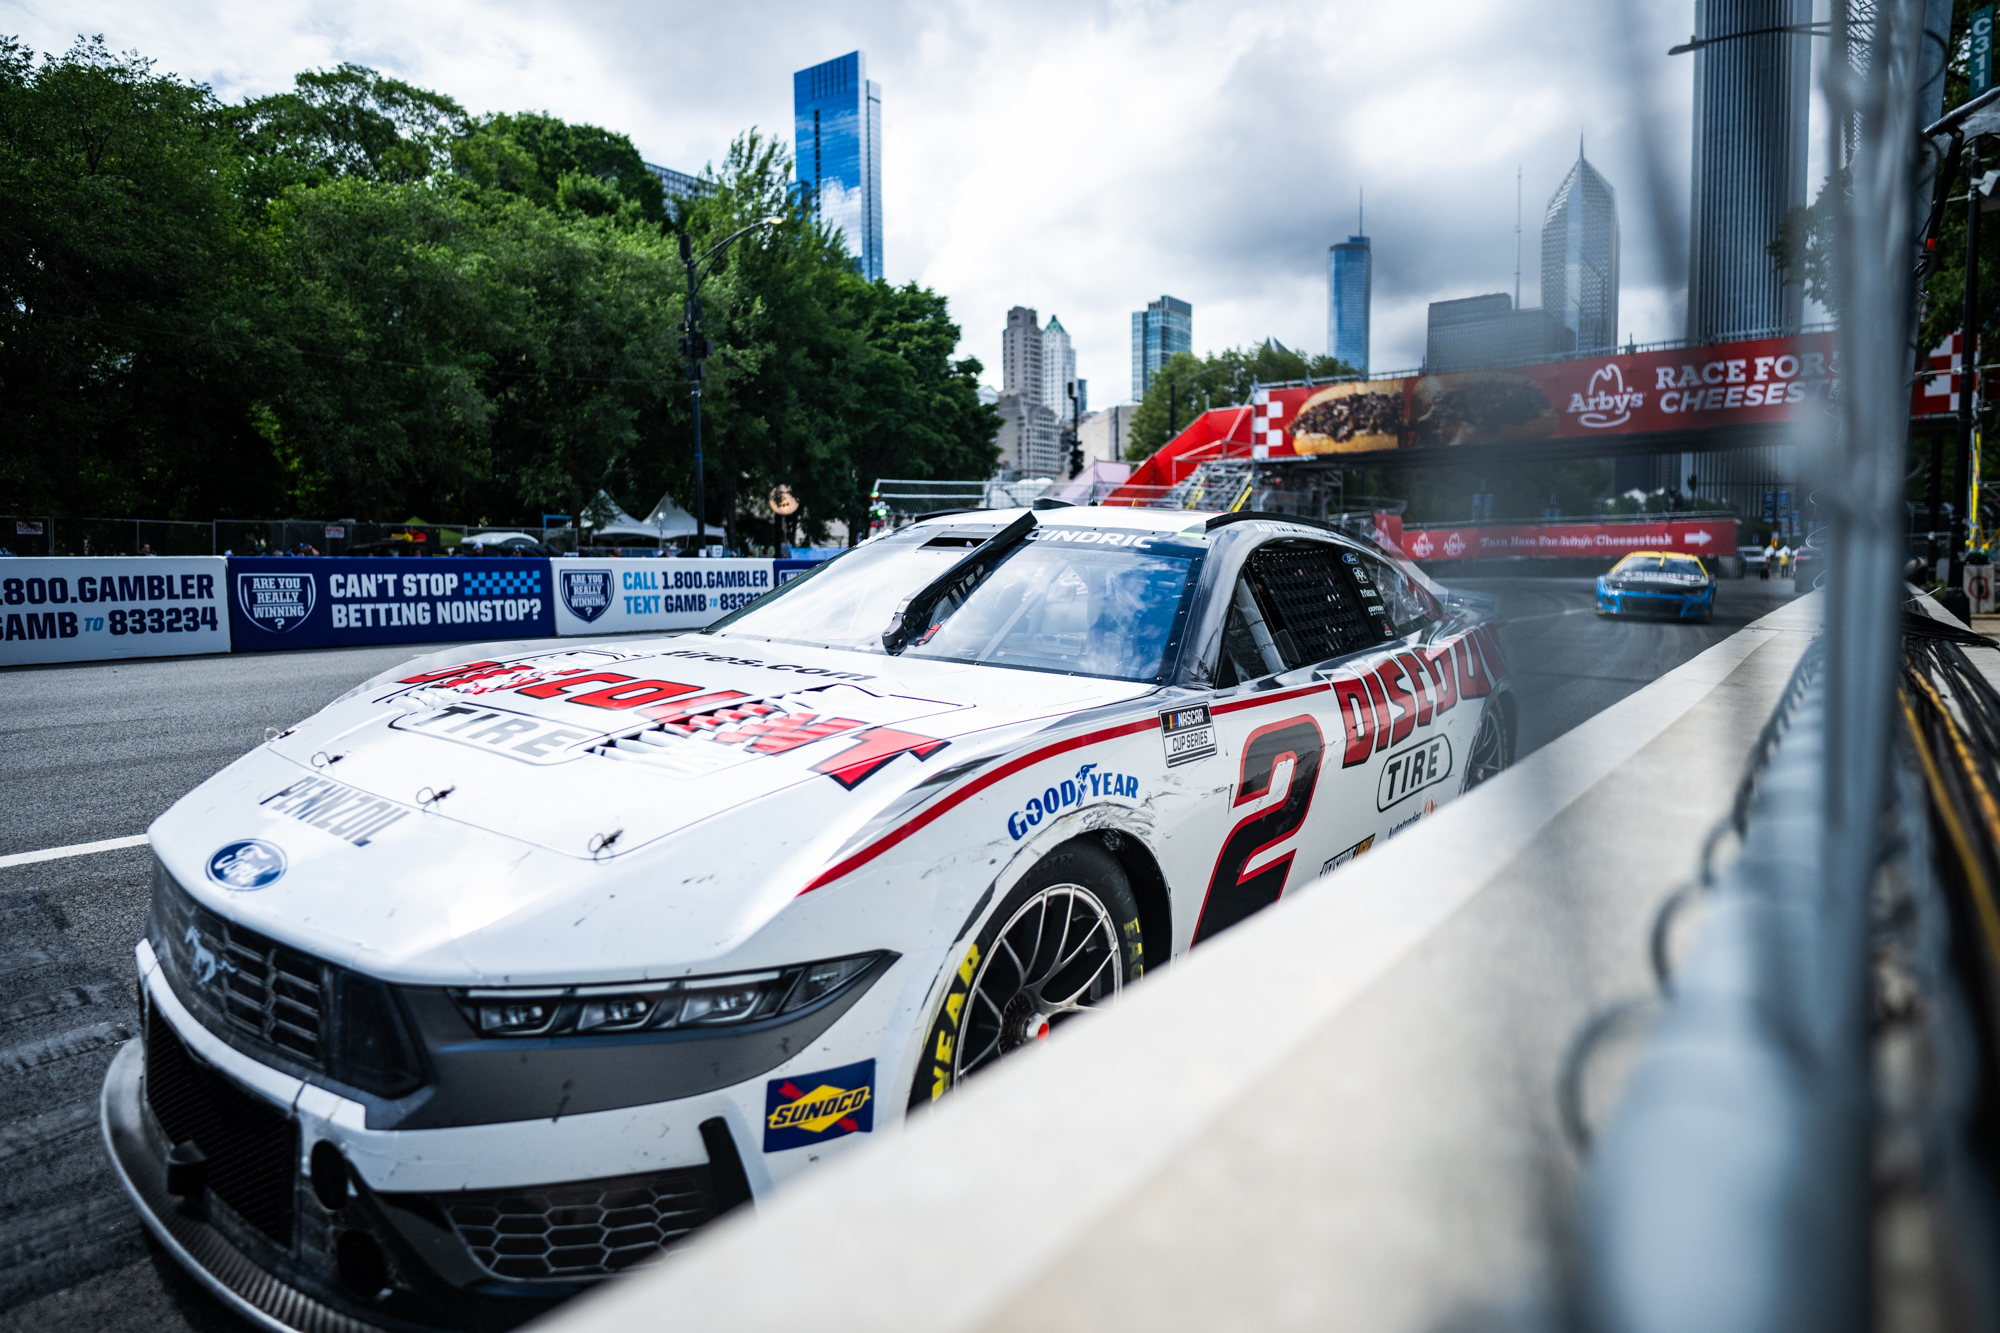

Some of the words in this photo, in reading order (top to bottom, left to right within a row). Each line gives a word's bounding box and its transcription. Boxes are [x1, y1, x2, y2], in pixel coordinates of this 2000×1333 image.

[1655, 359, 1746, 390] RACE
[1753, 352, 1826, 381] FOR
[1566, 386, 1644, 415] Arby's
[1024, 529, 1159, 549] CINDRIC
[1594, 533, 1672, 546] Cheesesteak
[253, 578, 276, 589] ARE
[278, 577, 301, 589] YOU
[330, 573, 397, 598] CAN'T
[402, 573, 459, 597] STOP
[571, 574, 587, 584] ARE
[588, 573, 603, 583] YOU
[623, 571, 659, 591] CALL
[662, 570, 769, 590] 1.800.GAMBLER
[257, 592, 299, 604] REALLY
[573, 585, 602, 595] REALLY
[253, 605, 305, 618] WINNING
[571, 596, 606, 607] WINNING
[624, 595, 661, 615] TEXT
[664, 593, 707, 613] GAMB
[709, 598, 718, 608] TO
[0, 611, 79, 641] AMB
[84, 617, 104, 632] TO
[109, 606, 218, 636] 833234
[331, 602, 431, 628] BETTING
[436, 598, 541, 624] NONSTOP?
[660, 650, 878, 682] tires.com
[1178, 708, 1204, 729] NASCAR
[417, 705, 577, 757] TIRE
[1172, 736, 1186, 752] CUP
[1186, 730, 1208, 749] SERIES
[1387, 742, 1440, 801] TIRE
[1190, 713, 1325, 950] 2
[932, 943, 982, 1103] YEAR
[774, 1088, 868, 1126] SUNOCO
